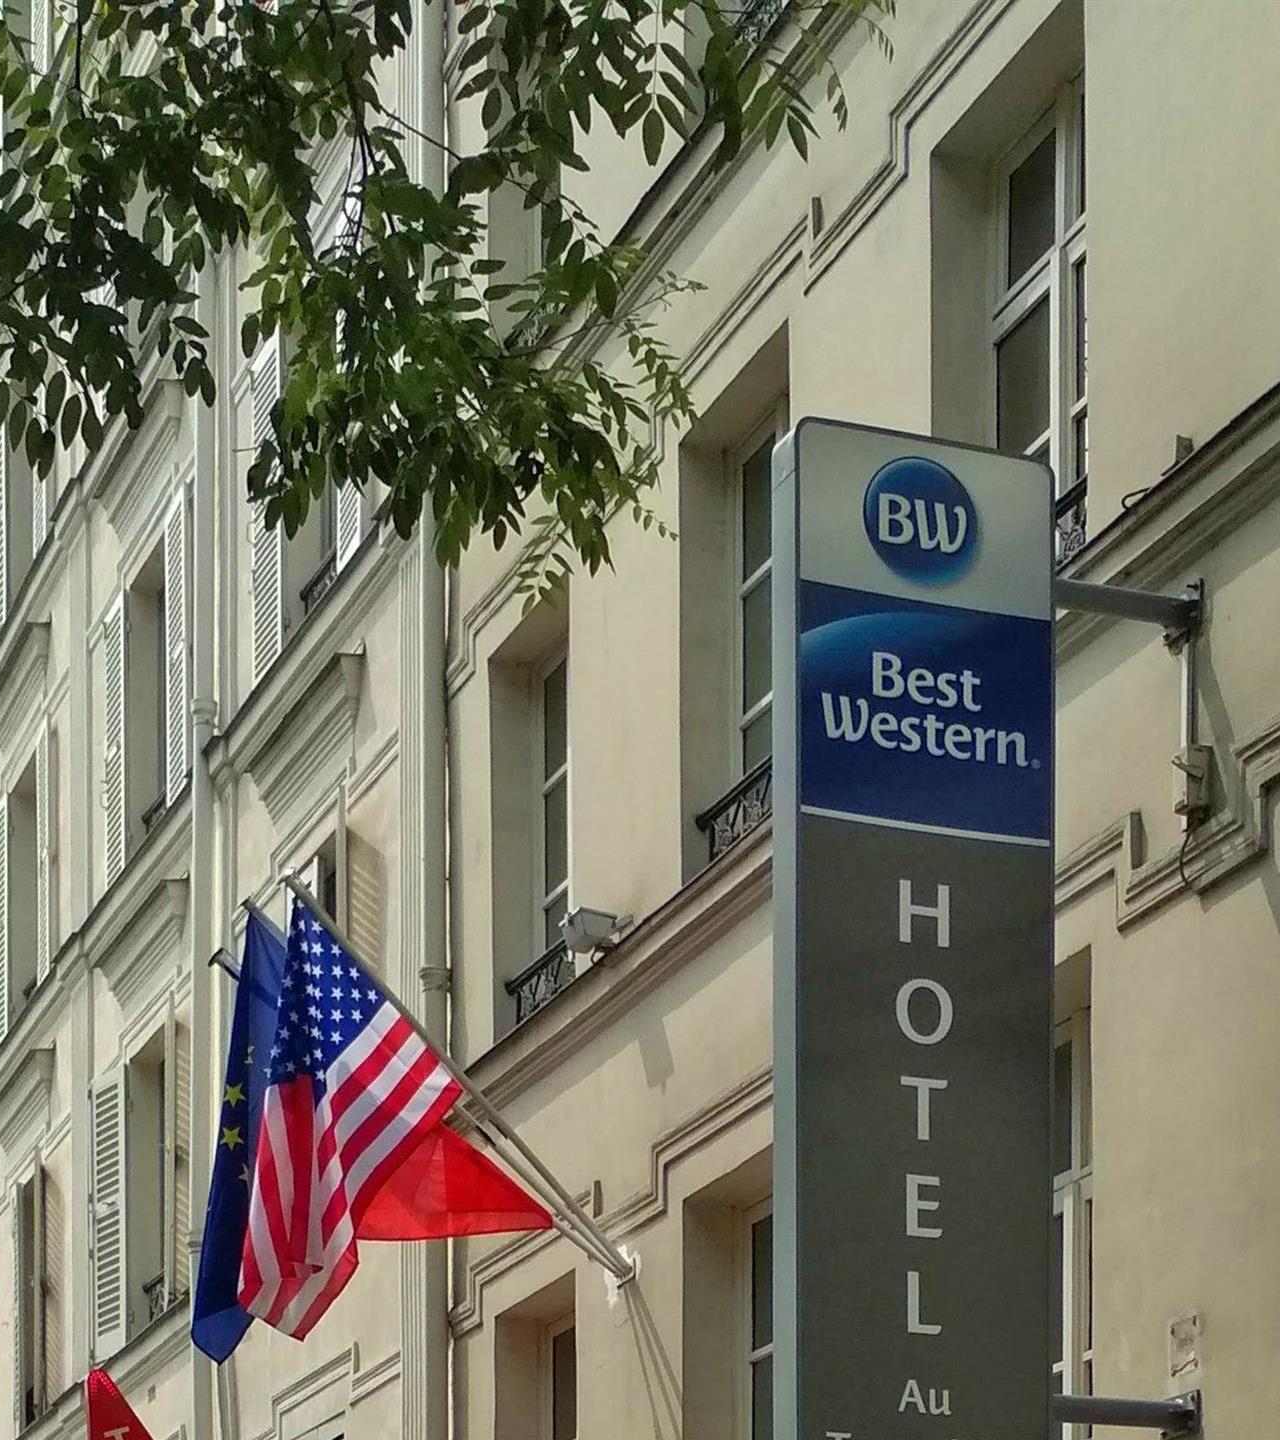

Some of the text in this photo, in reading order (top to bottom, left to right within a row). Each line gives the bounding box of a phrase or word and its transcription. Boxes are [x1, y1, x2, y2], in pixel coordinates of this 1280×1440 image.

[877, 492, 968, 554] BW
[871, 650, 983, 713] Best
[821, 692, 1029, 768] Western
[894, 878, 955, 1336] HOTEL
[897, 1378, 953, 1416] Au
